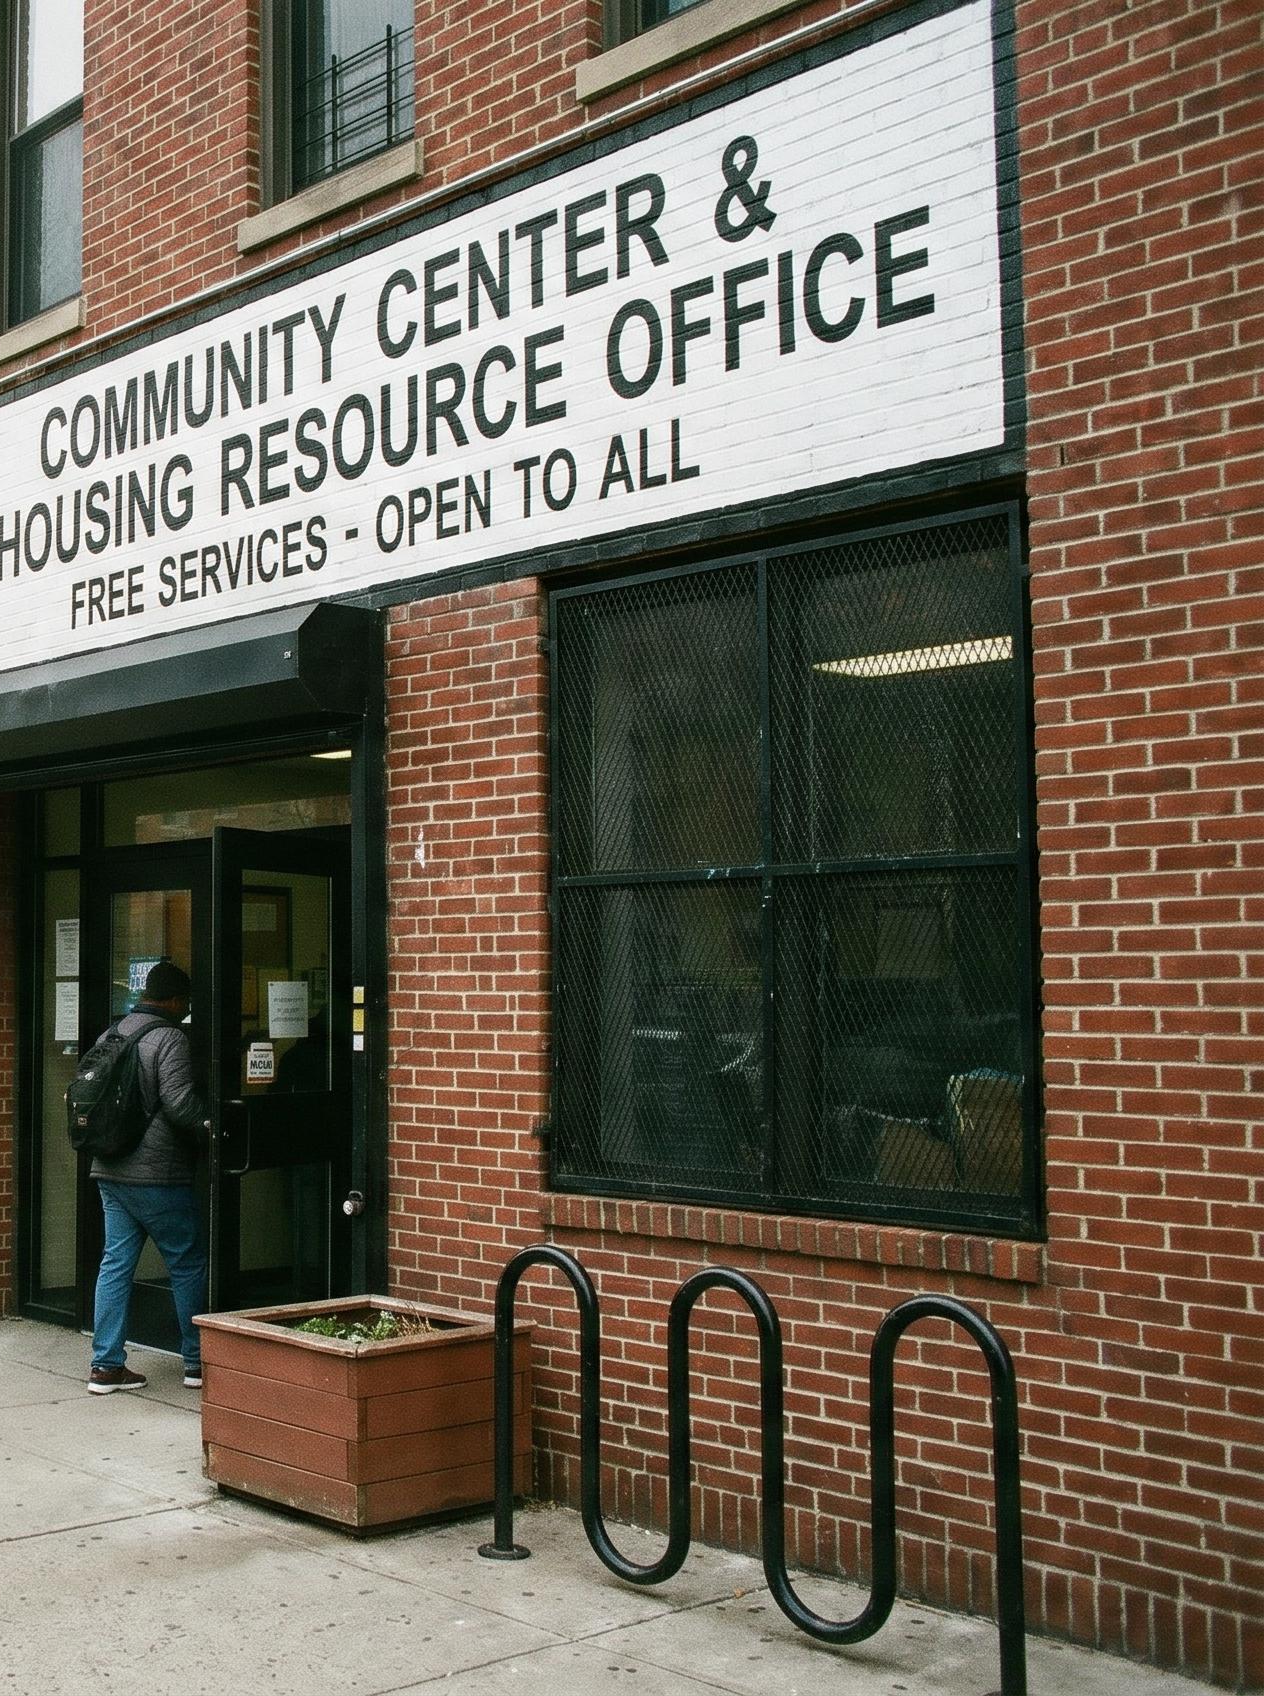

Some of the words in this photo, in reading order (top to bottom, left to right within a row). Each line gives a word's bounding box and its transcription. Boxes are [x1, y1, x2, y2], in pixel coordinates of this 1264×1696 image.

[40, 294, 346, 481] COMMUNITY
[377, 174, 670, 358] CENTER
[715, 135, 778, 243] &
[221, 325, 567, 517] RESOURCE
[606, 205, 935, 400] OFFICE
[71, 565, 144, 630] FREE
[158, 515, 329, 607] SERVICES
[345, 527, 359, 541] -
[375, 469, 492, 555] OPEN
[514, 448, 577, 519] TO
[599, 418, 701, 500] ALL
